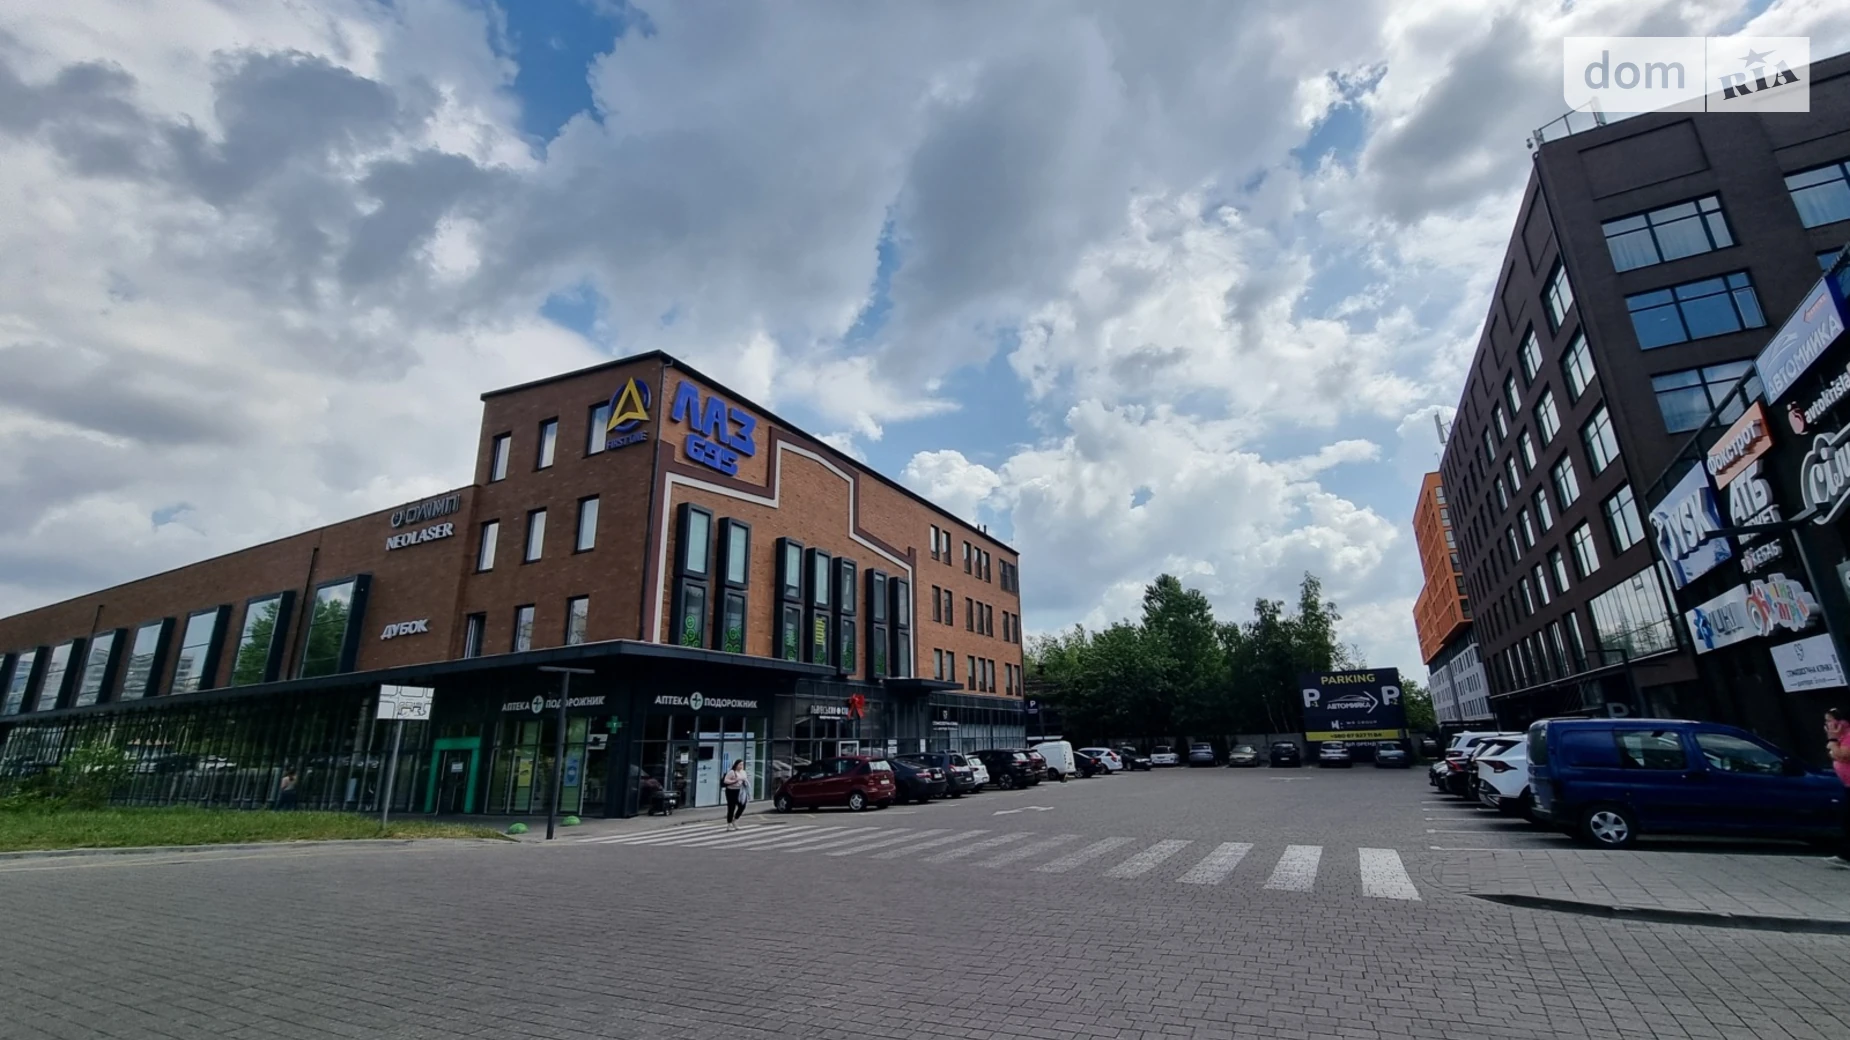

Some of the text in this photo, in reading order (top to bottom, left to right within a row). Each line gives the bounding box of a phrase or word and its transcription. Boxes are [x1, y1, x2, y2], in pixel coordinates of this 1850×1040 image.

[672, 380, 756, 457] ЛАЗ
[685, 433, 739, 476] 695
[1731, 459, 1773, 526] АТБ
[386, 522, 454, 550] NEOLASER
[380, 619, 430, 640] ДУБОК
[1321, 673, 1375, 685] PARKING
[655, 695, 758, 708] АПТЕКА ПОДОРОЖНИК
[1303, 688, 1321, 708] P
[1381, 686, 1400, 705] P
[502, 702, 530, 711] АПТЕКА
